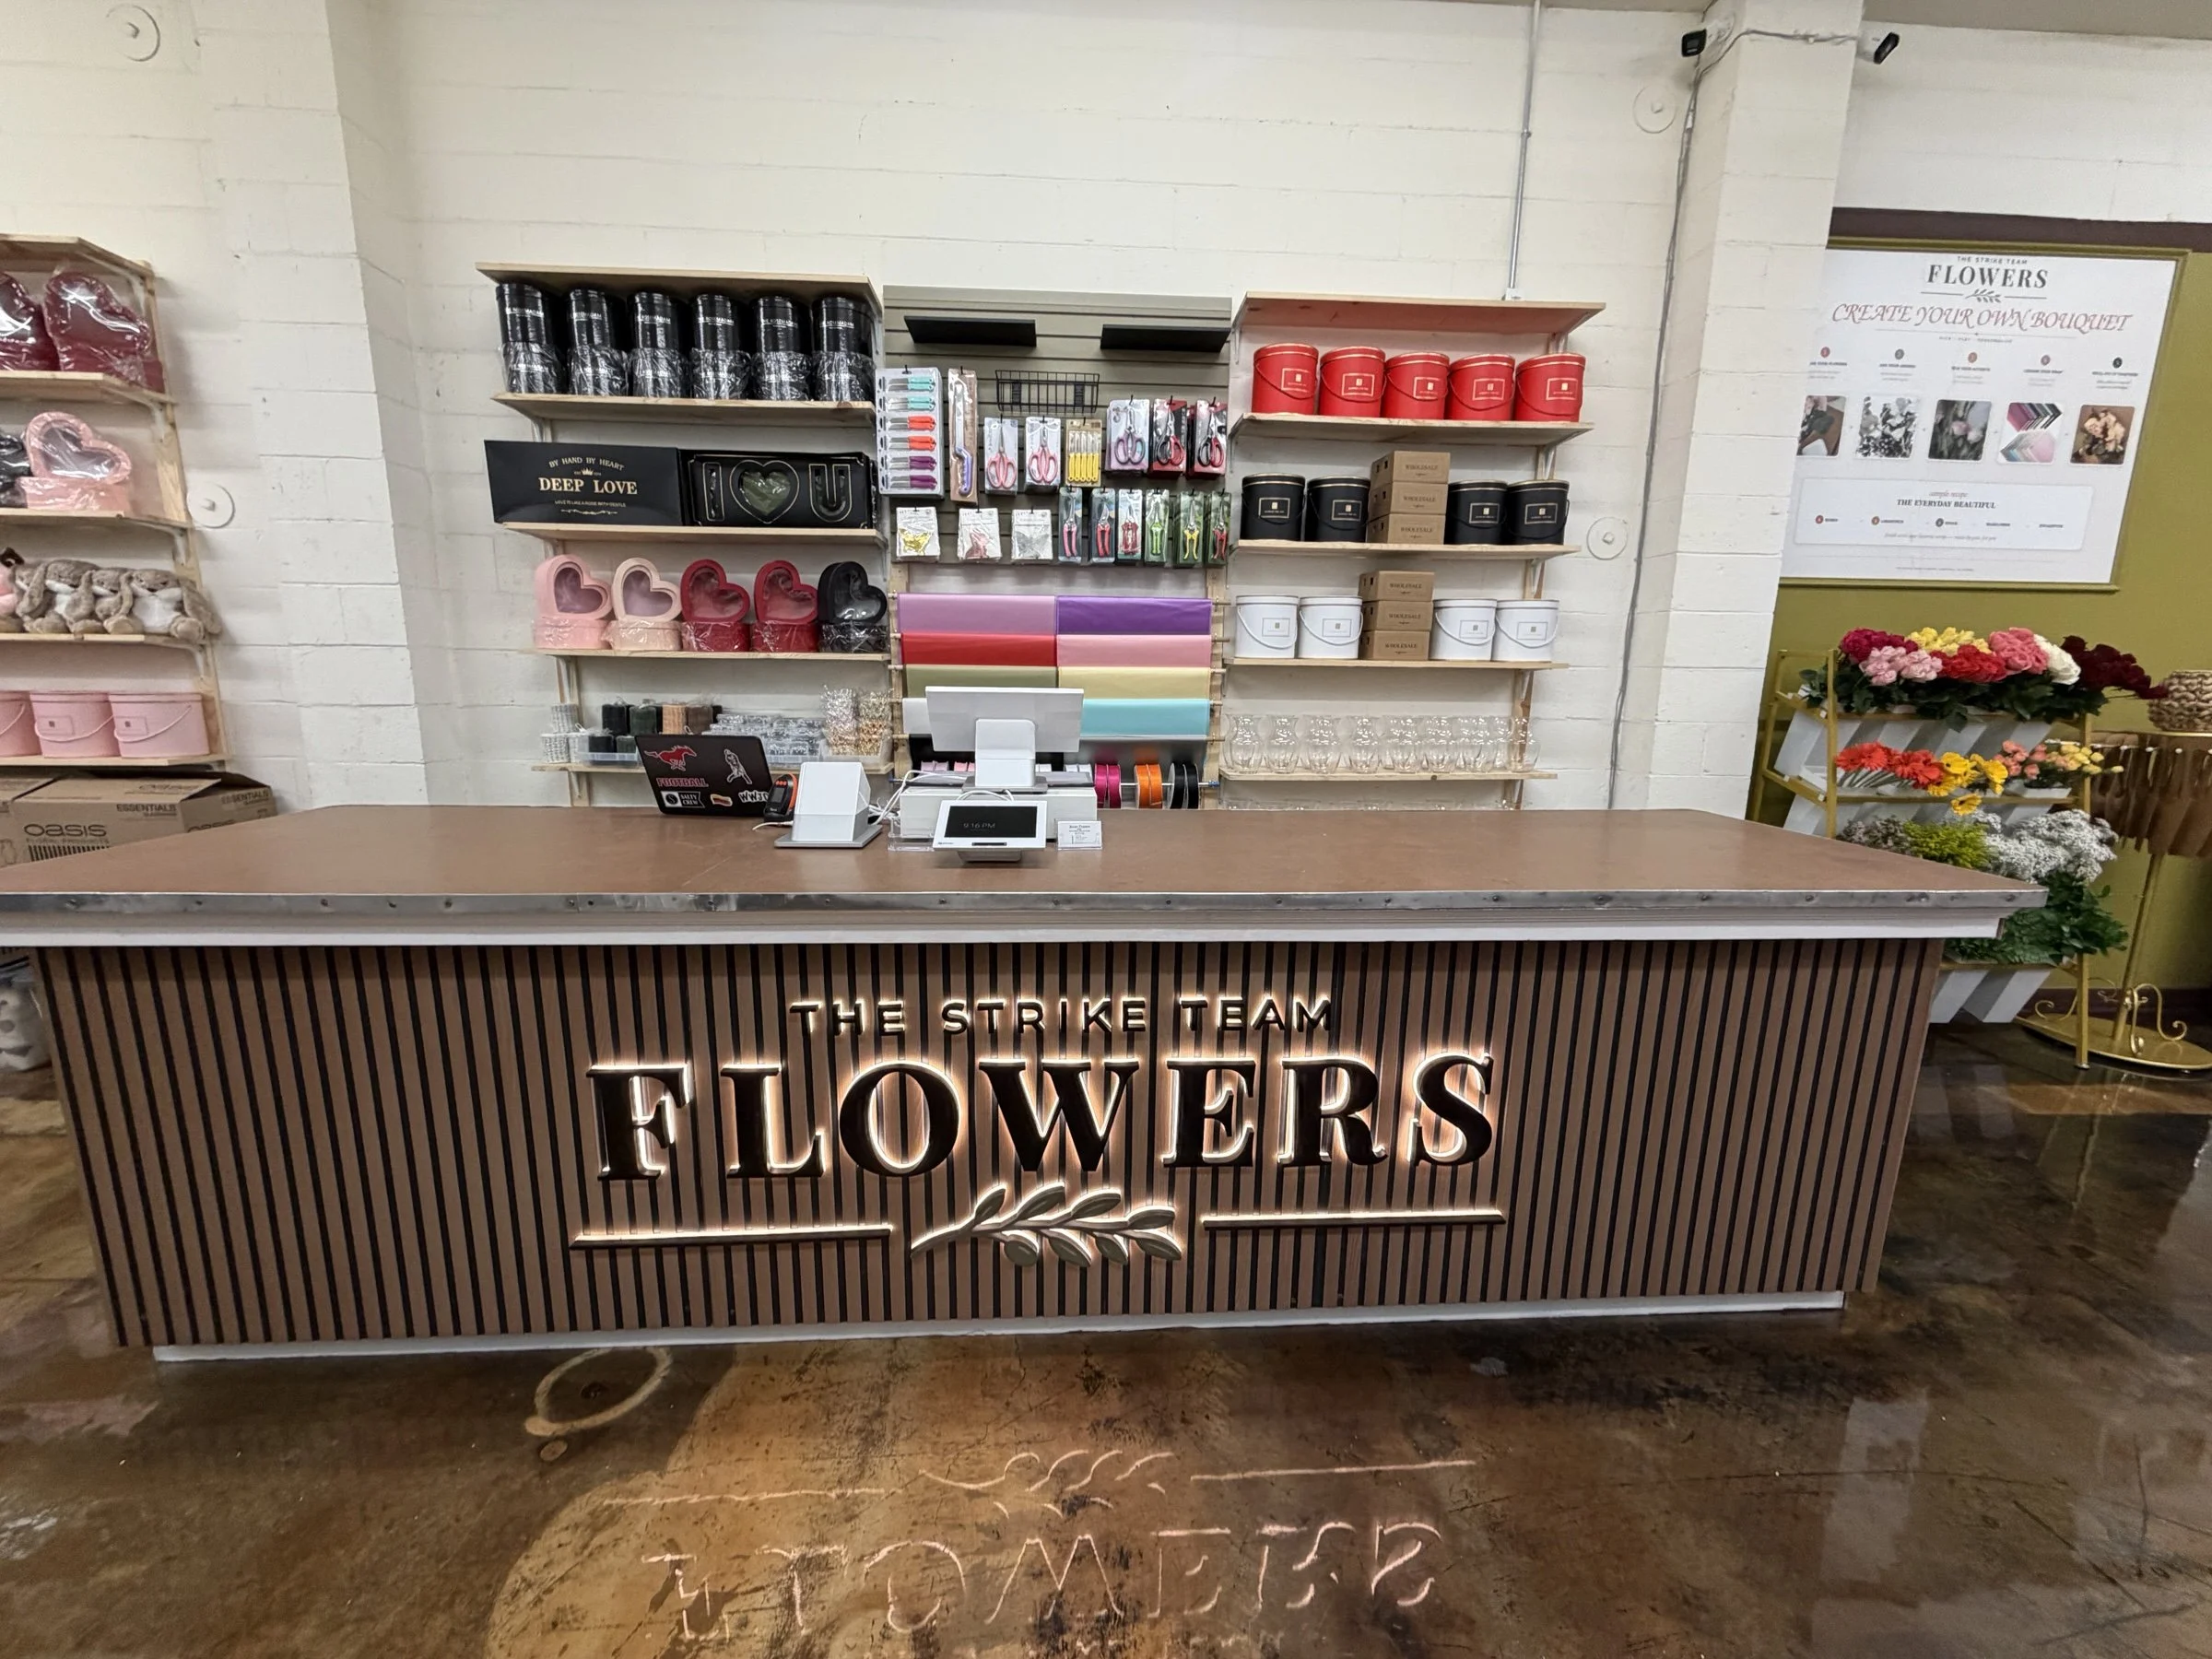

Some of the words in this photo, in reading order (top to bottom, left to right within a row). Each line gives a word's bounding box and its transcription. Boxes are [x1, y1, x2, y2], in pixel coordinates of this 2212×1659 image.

[1927, 265, 2049, 288] FLOWERS
[1831, 304, 1912, 324] CREATE
[1914, 306, 1976, 328] YOUR
[1977, 308, 2030, 331] OWN
[2030, 312, 2134, 335] BOUQUET
[548, 459, 559, 468] BY
[561, 456, 583, 465] HAND
[599, 458, 625, 471] HEART
[538, 477, 584, 492] DEEP
[593, 479, 638, 495] LOVE
[1897, 499, 1912, 507] THE
[1914, 500, 1952, 508] EVERYDAY
[1954, 500, 1996, 510] BEAUTIFUL
[655, 777, 709, 788] FOOTBALL
[116, 804, 177, 812] ESSENTIALS
[790, 1000, 905, 1036] THE
[941, 998, 1146, 1035] STRIKE
[1179, 997, 1333, 1033] TEAM
[587, 1052, 1493, 1182] FLOWERS
